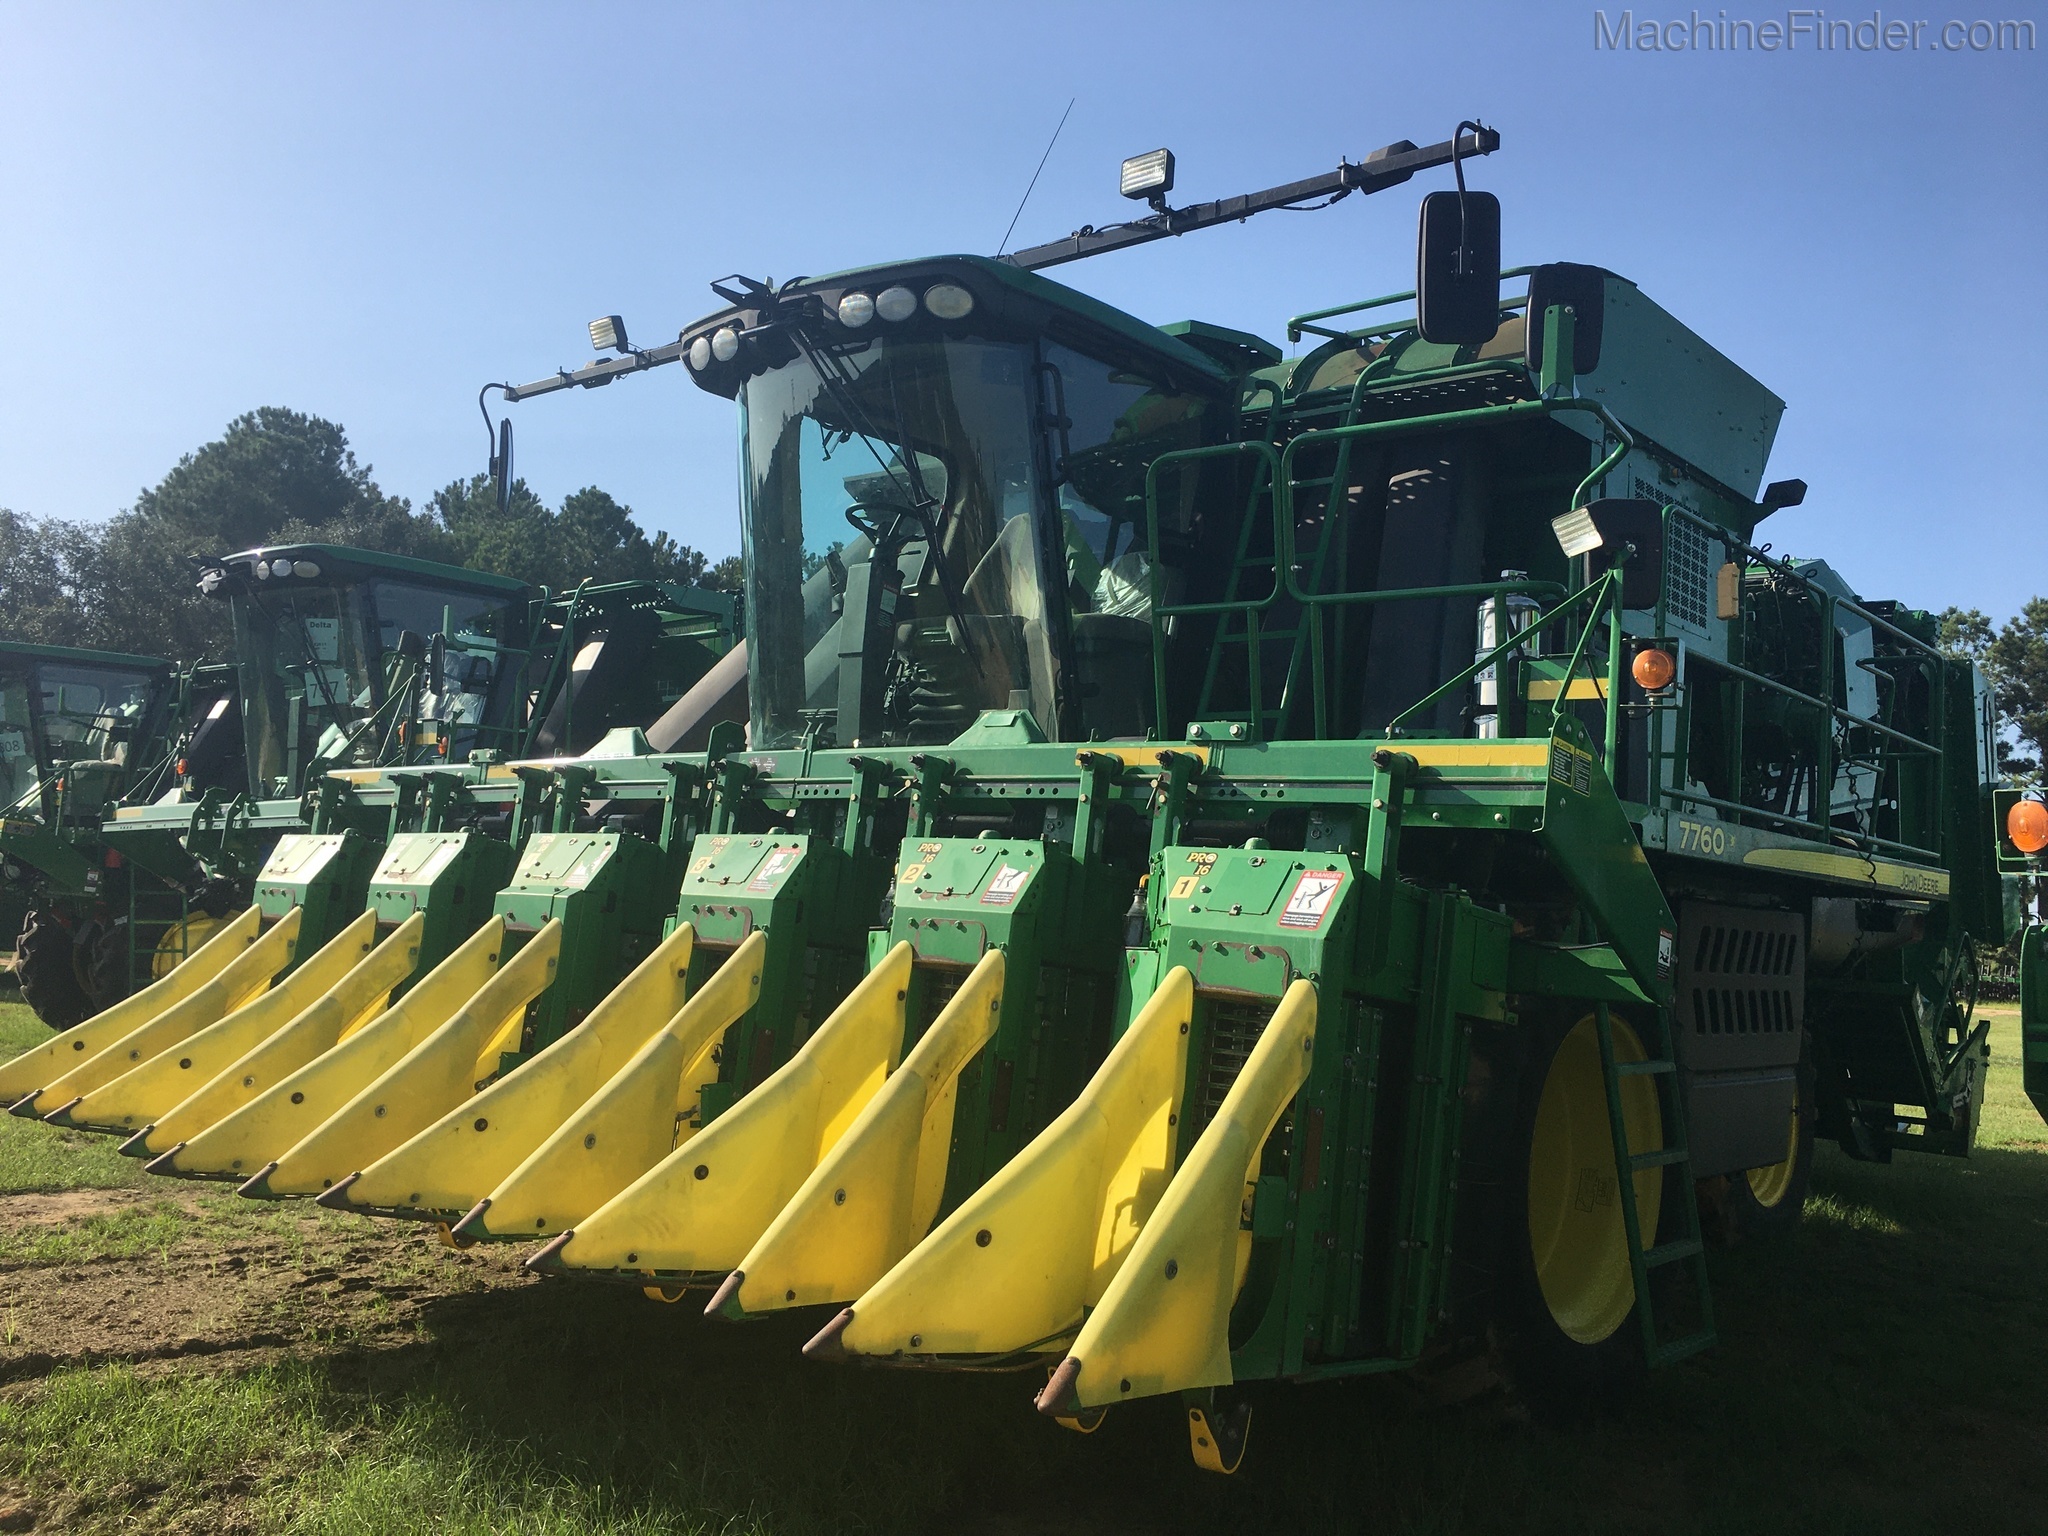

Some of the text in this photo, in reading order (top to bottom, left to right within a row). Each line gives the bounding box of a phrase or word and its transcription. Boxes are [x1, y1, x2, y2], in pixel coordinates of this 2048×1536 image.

[310, 621, 332, 629] Delta
[309, 681, 339, 699] 77
[1680, 820, 1725, 856] 7760
[917, 843, 942, 853] PRO
[922, 854, 936, 864] 16
[1186, 852, 1218, 864] PRO
[694, 859, 708, 871] 3
[1194, 864, 1212, 876] 16
[904, 867, 919, 881] 2
[1311, 871, 1343, 879] DANGER
[1179, 879, 1191, 895] 1
